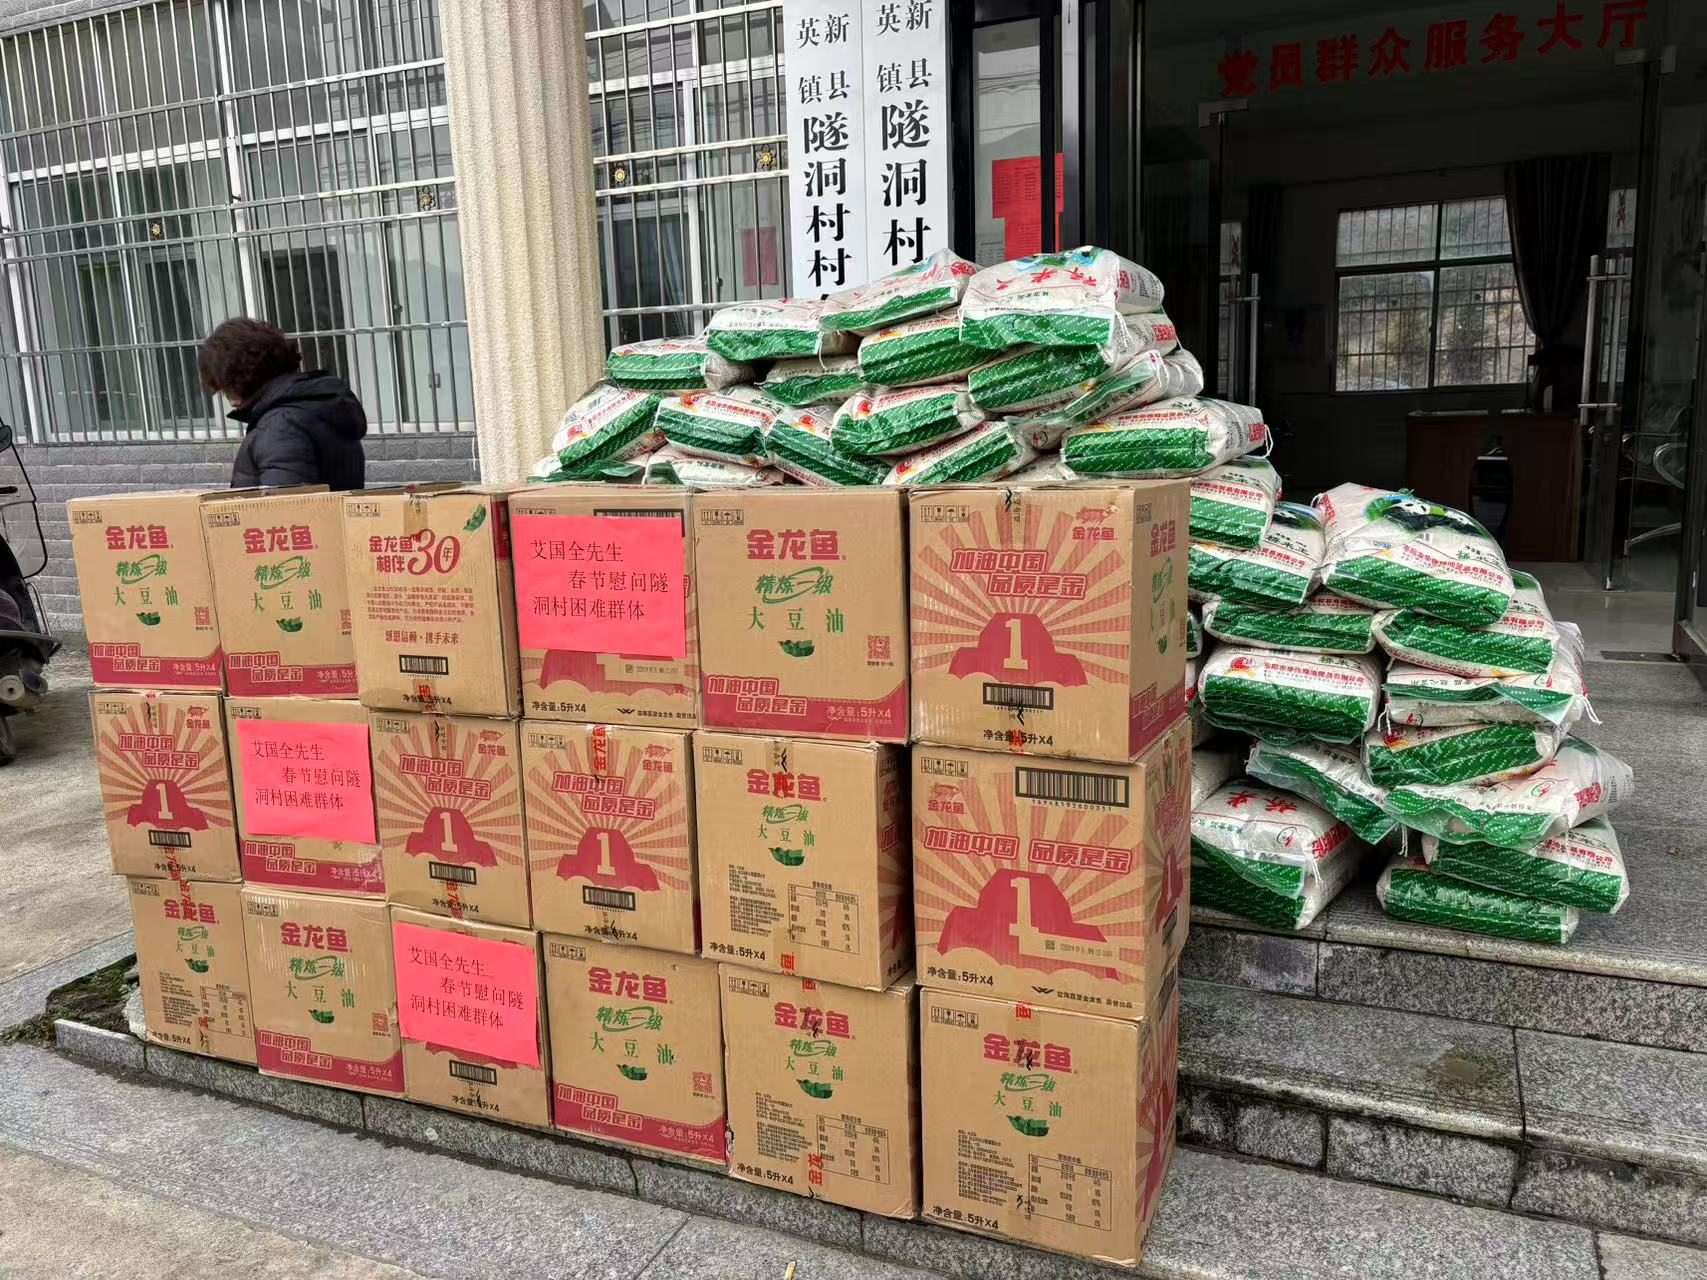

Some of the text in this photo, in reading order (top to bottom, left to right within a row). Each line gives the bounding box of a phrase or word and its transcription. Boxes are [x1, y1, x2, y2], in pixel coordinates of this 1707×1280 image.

[1217, 1, 1648, 98] 党员群众服务大厅
[803, 111, 852, 300] 隧洞村村
[105, 524, 170, 550] 金龙鱼
[243, 525, 313, 553] 金龙鱼
[368, 535, 414, 553] 金龙鱼
[747, 529, 840, 560] 金龙鱼
[1072, 526, 1115, 541] 金龙鱼
[529, 540, 625, 564] 艾国全先生
[952, 551, 1047, 573] 加油中国
[116, 559, 168, 579] 精炼一级
[255, 561, 312, 582] 精炼一级
[376, 555, 405, 574] 相伴
[568, 569, 669, 593] 春节慰问隧
[755, 573, 833, 595] 精炼一级
[988, 575, 1087, 598] 品质是金
[113, 586, 179, 607] 大豆油
[252, 589, 323, 612] 大豆油
[532, 595, 646, 621] 洞村困难群体
[748, 606, 844, 633] 大豆油
[93, 643, 140, 658] 加油中国
[1003, 618, 1028, 670] 1
[112, 657, 160, 672] 品质是金
[229, 652, 280, 669] 加油中国
[251, 666, 304, 683] 品质是金
[708, 677, 776, 698] 加油中国
[737, 698, 807, 716] 品质是金
[186, 719, 211, 729] 金龙鱼
[119, 734, 173, 750] 加油中国
[251, 740, 325, 761] 艾国全先生
[478, 745, 506, 755] 金龙鱼
[142, 752, 199, 769] 品质是金
[401, 755, 464, 777] 加油中国
[642, 760, 674, 773] 金龙鱼
[281, 766, 361, 788] 春节慰问隧
[553, 773, 625, 795] 加油中国
[747, 768, 822, 801] 金龙鱼
[255, 788, 344, 810] 洞村困难群体
[426, 777, 491, 800] 品质是金
[155, 783, 174, 820] 1
[583, 796, 655, 819] 品质是金
[928, 801, 965, 815] 金龙鱼
[762, 805, 808, 823] 精炼一级
[440, 812, 458, 852] 1
[758, 824, 815, 847] 大豆油
[244, 842, 295, 858] 加油中国
[597, 832, 617, 876] 1
[926, 828, 1132, 873] 加油中国 品质是金
[266, 859, 317, 874] 品质是金
[164, 899, 217, 924] 金龙鱼
[178, 927, 208, 939] 精炼一级
[281, 922, 348, 952] 金龙鱼
[176, 942, 215, 958] 大豆油
[289, 957, 345, 978] 精炼一级
[408, 946, 486, 977] 艾国全先生
[286, 981, 355, 1009] 大豆油
[440, 977, 524, 1010] 春节慰问隧
[588, 967, 668, 1003] 金龙鱼
[410, 994, 504, 1029] 洞村困难群体
[596, 1006, 662, 1030] 精炼一级
[774, 1001, 851, 1039] 金龙鱼
[260, 1031, 311, 1050] 加油中国
[591, 1032, 675, 1065] 大豆油
[790, 1039, 837, 1057] 精炼一级
[281, 1050, 333, 1068] 品质是金
[984, 1033, 1073, 1074] 金龙鱼
[785, 1056, 844, 1081] 大豆油
[1000, 1072, 1056, 1093] 精炼一级
[558, 1084, 618, 1110] 加油中国
[993, 1091, 1063, 1119] 大豆油
[582, 1105, 643, 1130] 品质是金
